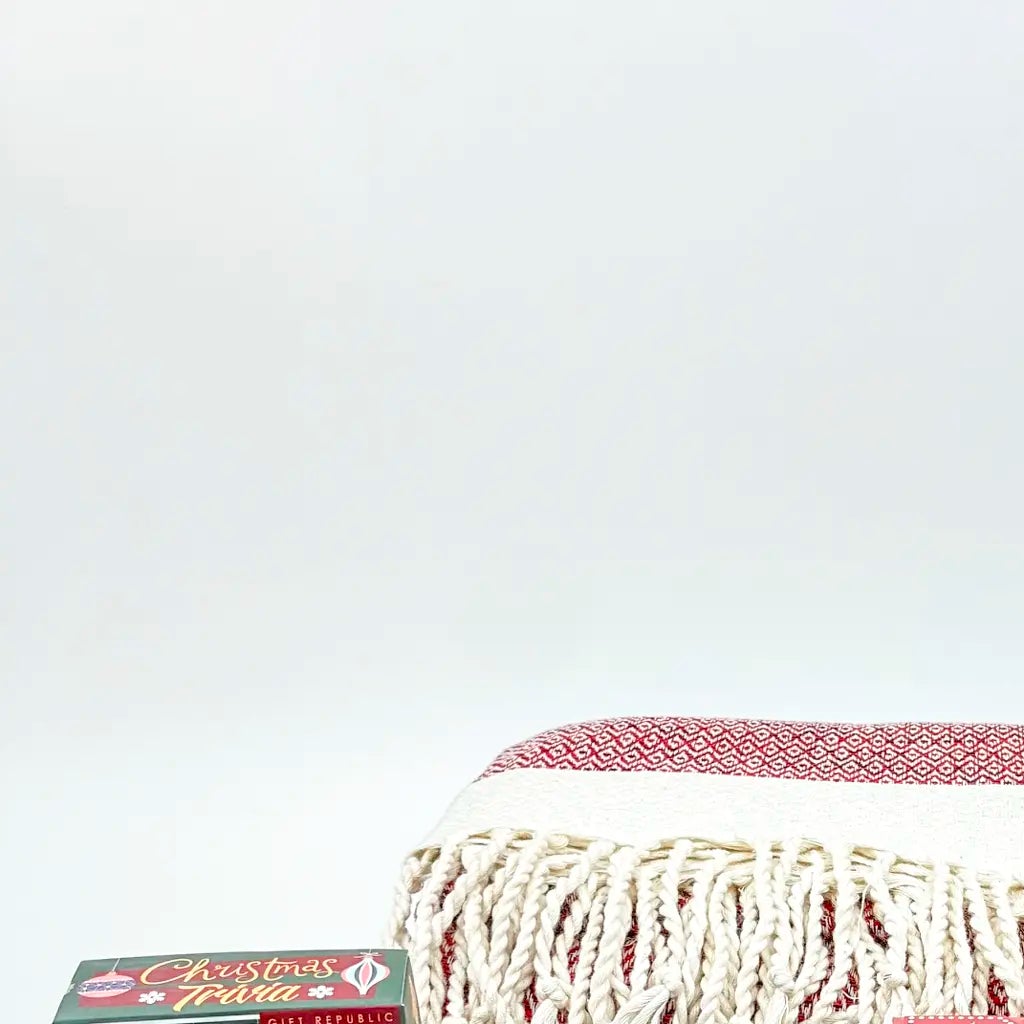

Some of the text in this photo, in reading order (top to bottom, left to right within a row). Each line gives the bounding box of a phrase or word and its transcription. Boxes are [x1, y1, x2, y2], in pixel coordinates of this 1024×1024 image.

[140, 957, 343, 986] Christmas
[172, 982, 303, 1012] Trivia
[314, 1011, 395, 1024] REPUBLIC
